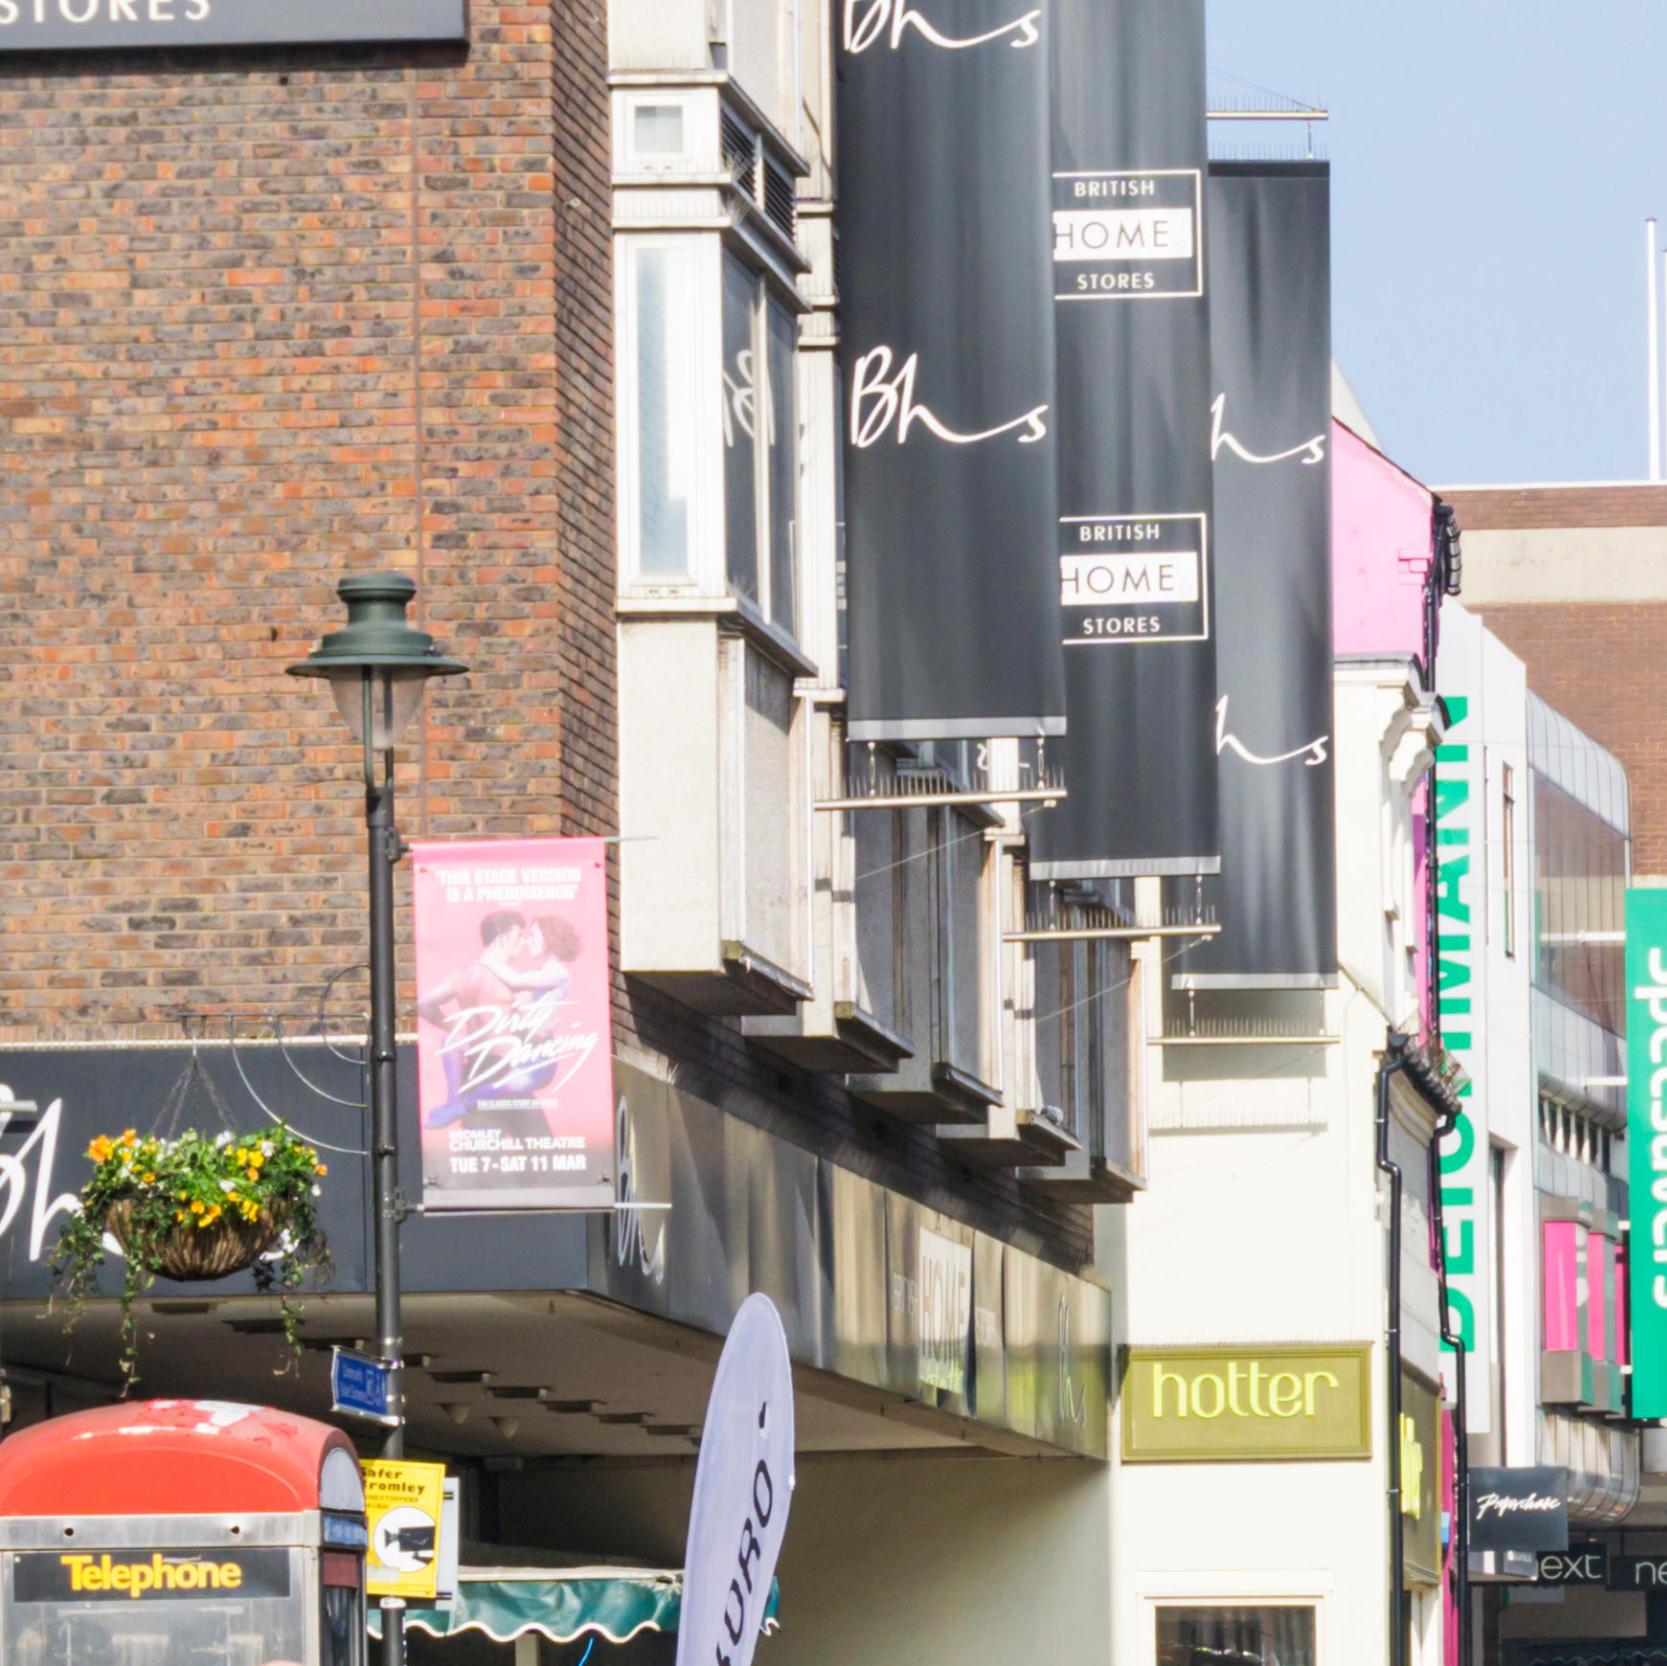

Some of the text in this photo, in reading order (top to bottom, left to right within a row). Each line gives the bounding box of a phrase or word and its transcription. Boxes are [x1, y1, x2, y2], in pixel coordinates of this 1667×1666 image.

[1073, 179, 1156, 198] BRITISH
[1054, 219, 1170, 250] HOME
[1077, 272, 1155, 291] STORES
[851, 346, 1048, 448] Bhs
[1210, 393, 1326, 465] hs
[1079, 523, 1161, 542] BRITISH
[1060, 565, 1176, 595] HOME
[1082, 616, 1162, 635] STORES
[1215, 694, 1329, 766] hs
[474, 868, 518, 885] STAGE
[521, 866, 581, 884] VERSION
[434, 990, 580, 1057] Dirty
[456, 1022, 599, 1095] Dancing
[449, 1136, 585, 1152] CHURCHILL THEATRE
[449, 1157, 478, 1173] TUE
[531, 1155, 549, 1171] 11
[552, 1154, 587, 1171] MAR
[1152, 1360, 1339, 1419] hotter
[366, 1481, 426, 1495] romley
[61, 1554, 242, 1600] Telephone
[1540, 1553, 1603, 1581] ext
